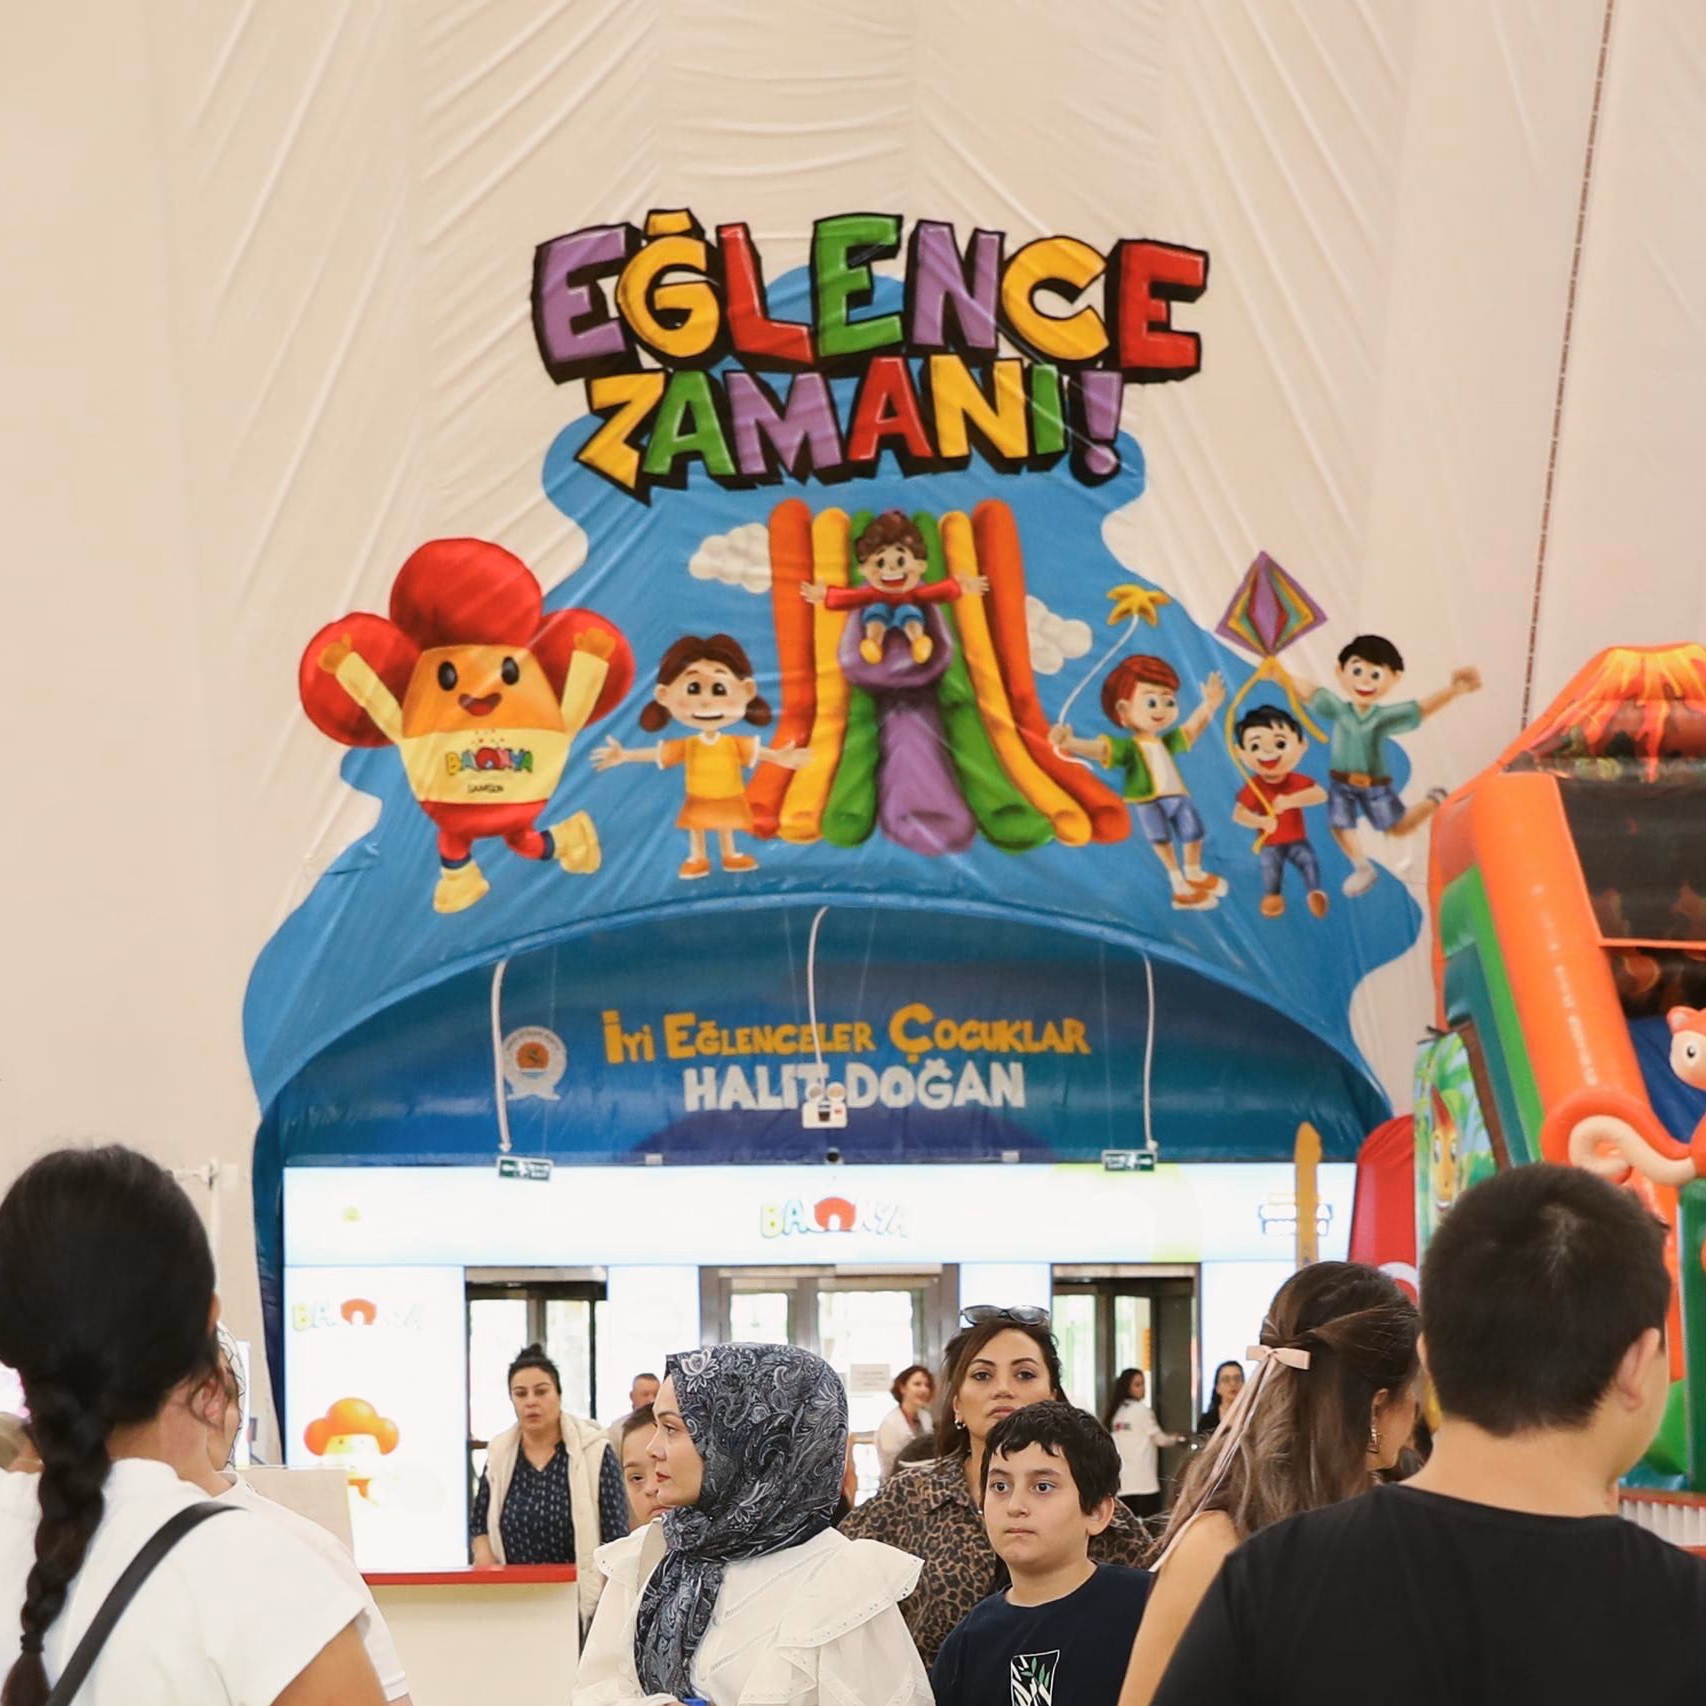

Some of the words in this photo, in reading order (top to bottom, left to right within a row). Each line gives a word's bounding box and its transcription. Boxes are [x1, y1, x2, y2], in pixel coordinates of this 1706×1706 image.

[531, 208, 1210, 384] EĞLENCE
[574, 353, 1125, 506] ZAMANI!
[844, 1060, 1026, 1110] DOĞAN
[889, 1003, 1091, 1064] ÇOCUKLAR
